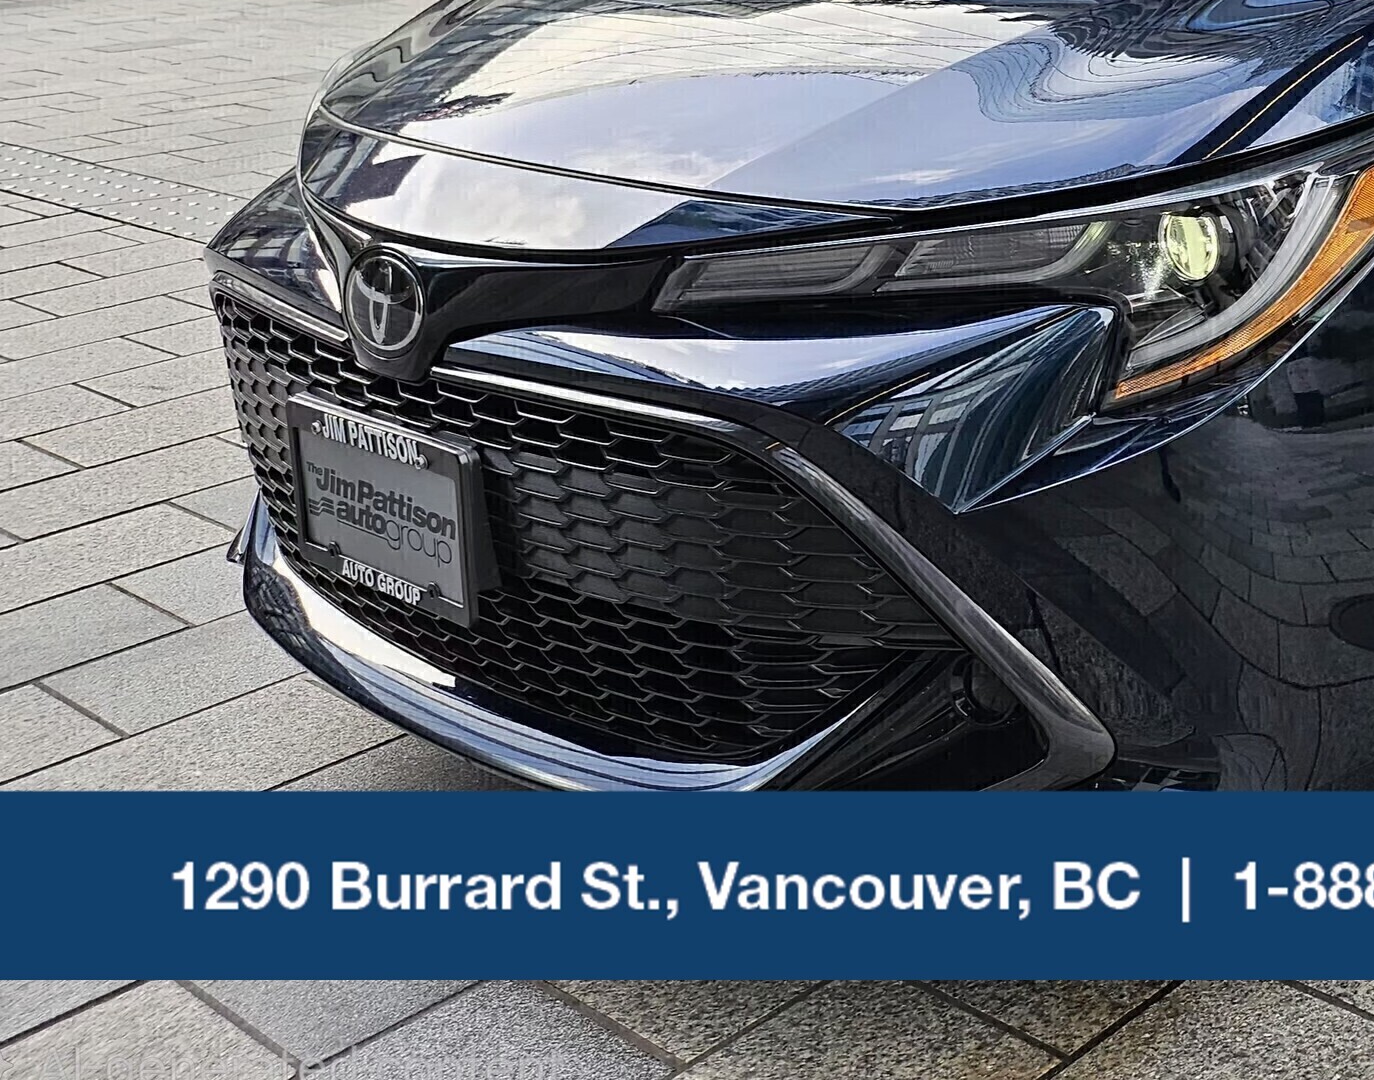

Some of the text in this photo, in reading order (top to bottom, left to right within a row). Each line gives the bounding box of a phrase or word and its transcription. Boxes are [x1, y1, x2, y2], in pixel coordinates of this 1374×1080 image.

[322, 413, 419, 466] JIM PATTISON
[306, 461, 323, 476] The
[342, 560, 422, 606] AUTO GROUP
